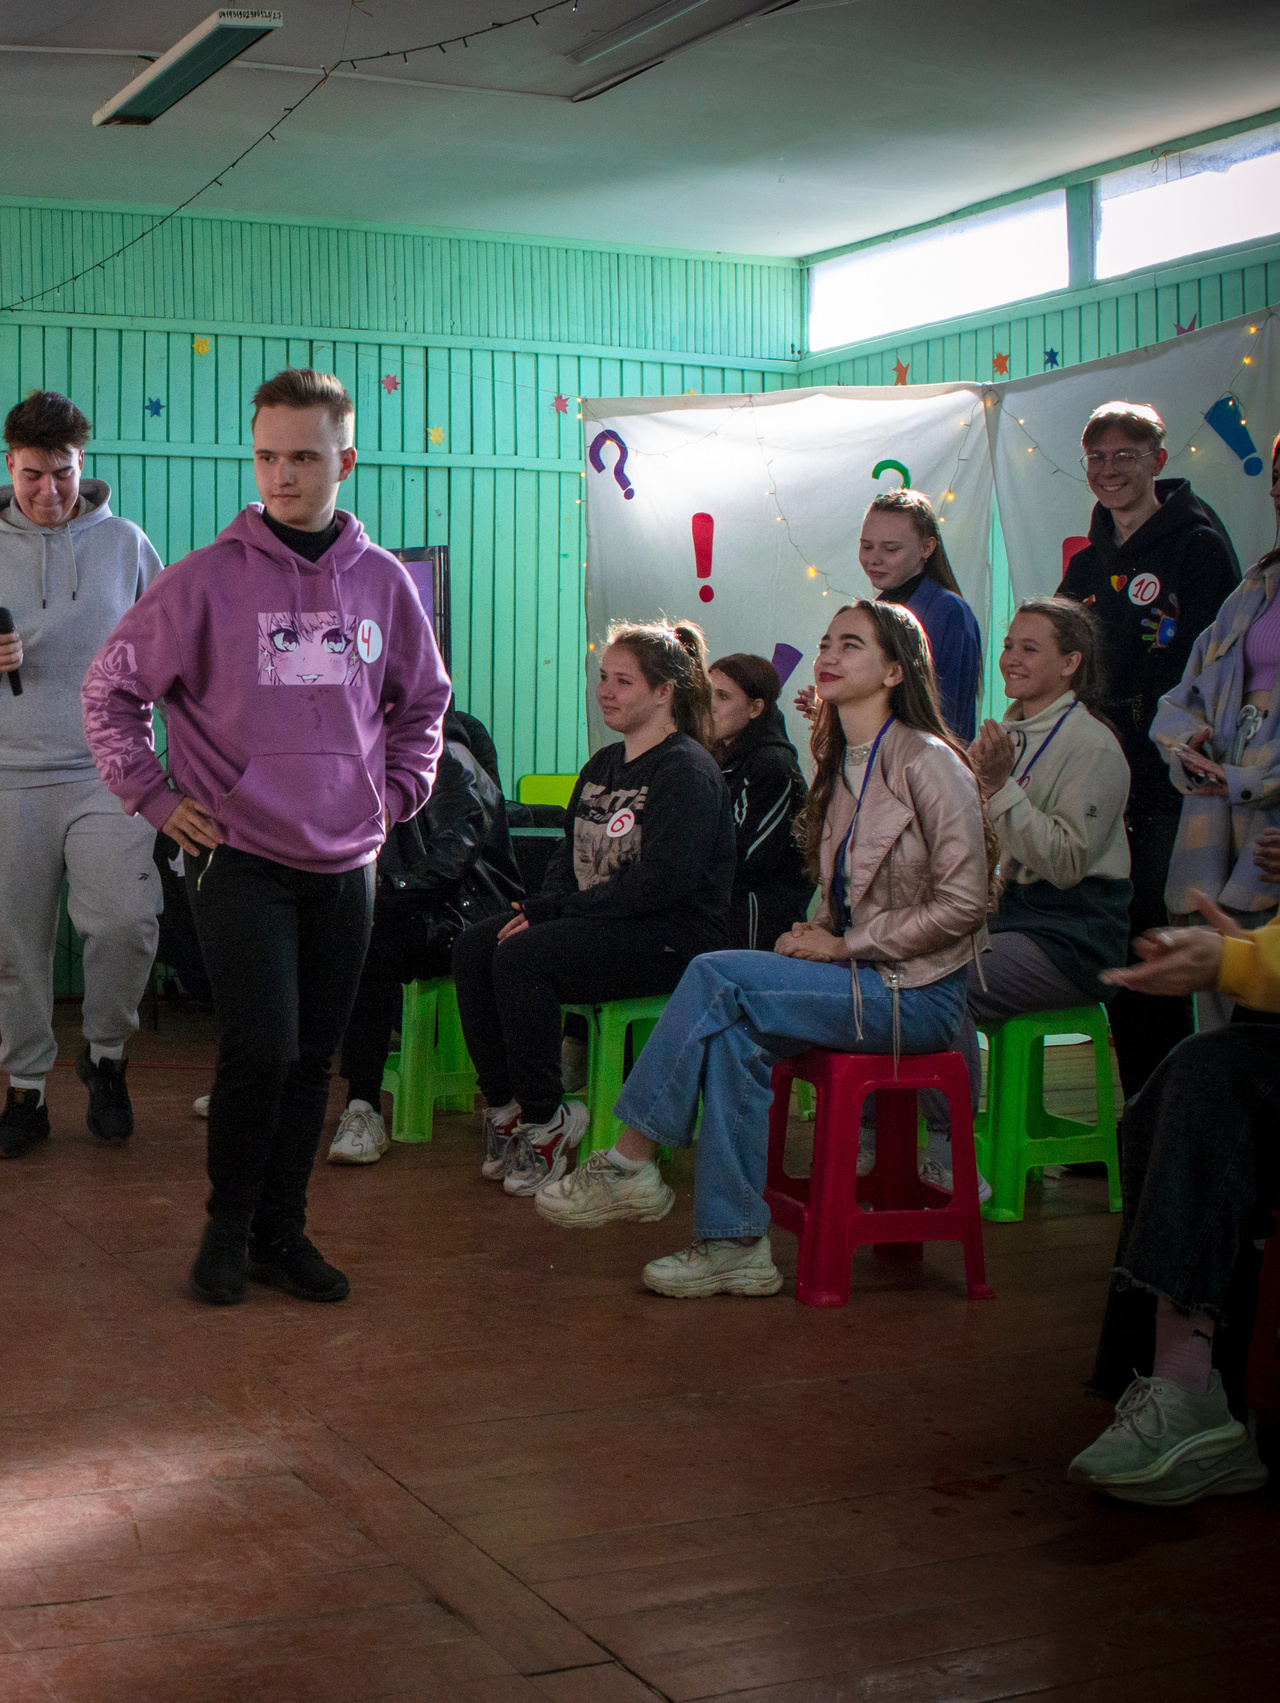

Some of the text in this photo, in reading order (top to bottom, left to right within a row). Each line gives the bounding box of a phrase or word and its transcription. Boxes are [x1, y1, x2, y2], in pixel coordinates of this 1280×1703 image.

[1132, 578, 1158, 602] 10
[361, 624, 372, 658] 4
[610, 813, 631, 833] 6
